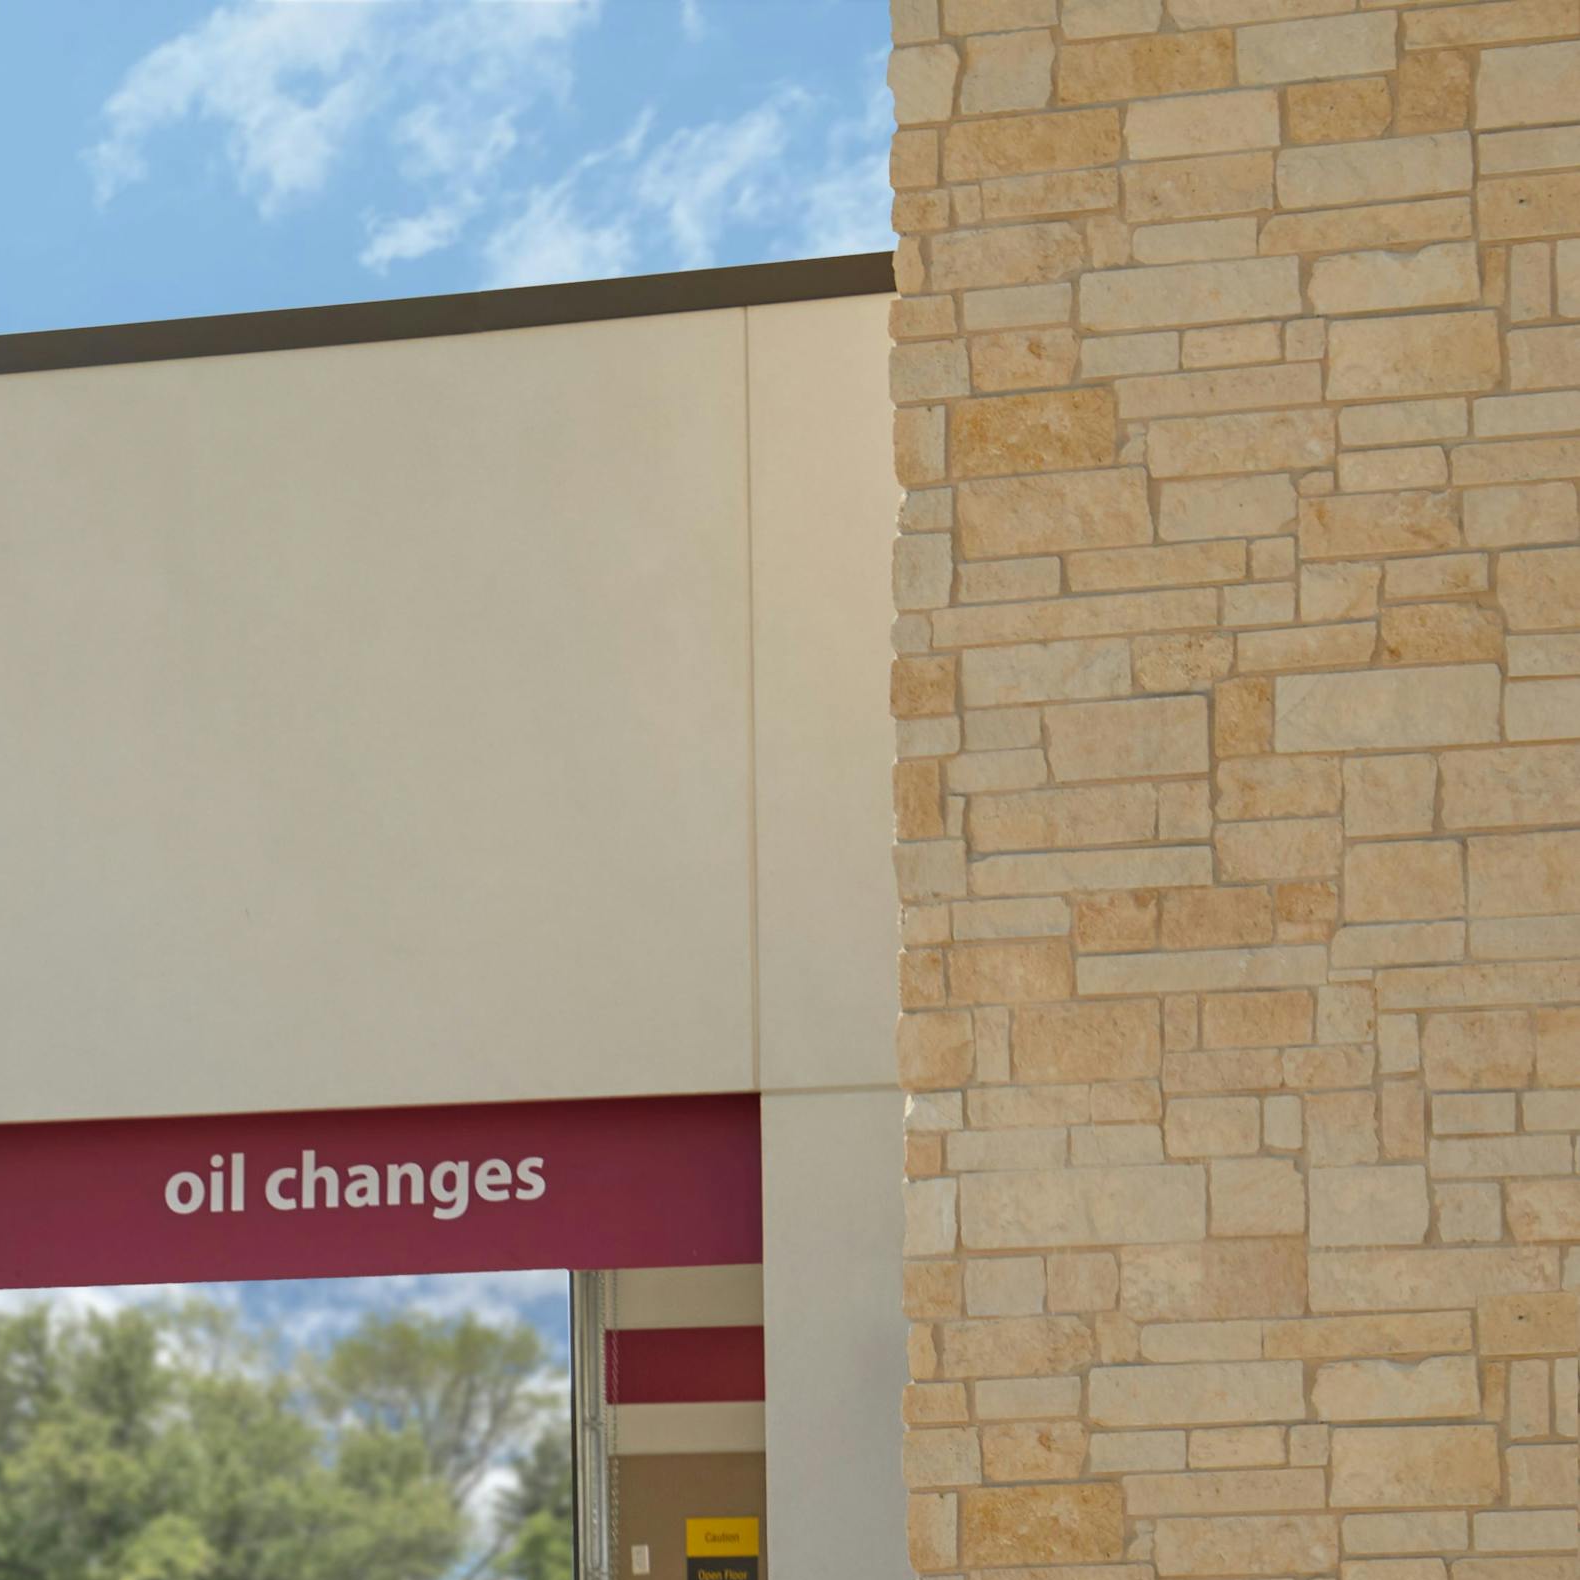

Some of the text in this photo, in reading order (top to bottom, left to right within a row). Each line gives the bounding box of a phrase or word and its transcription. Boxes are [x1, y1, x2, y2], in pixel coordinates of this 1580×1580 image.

[164, 1149, 546, 1221] oil changes
[704, 1531, 740, 1544] Caution
[724, 1568, 748, 1580] Floor
